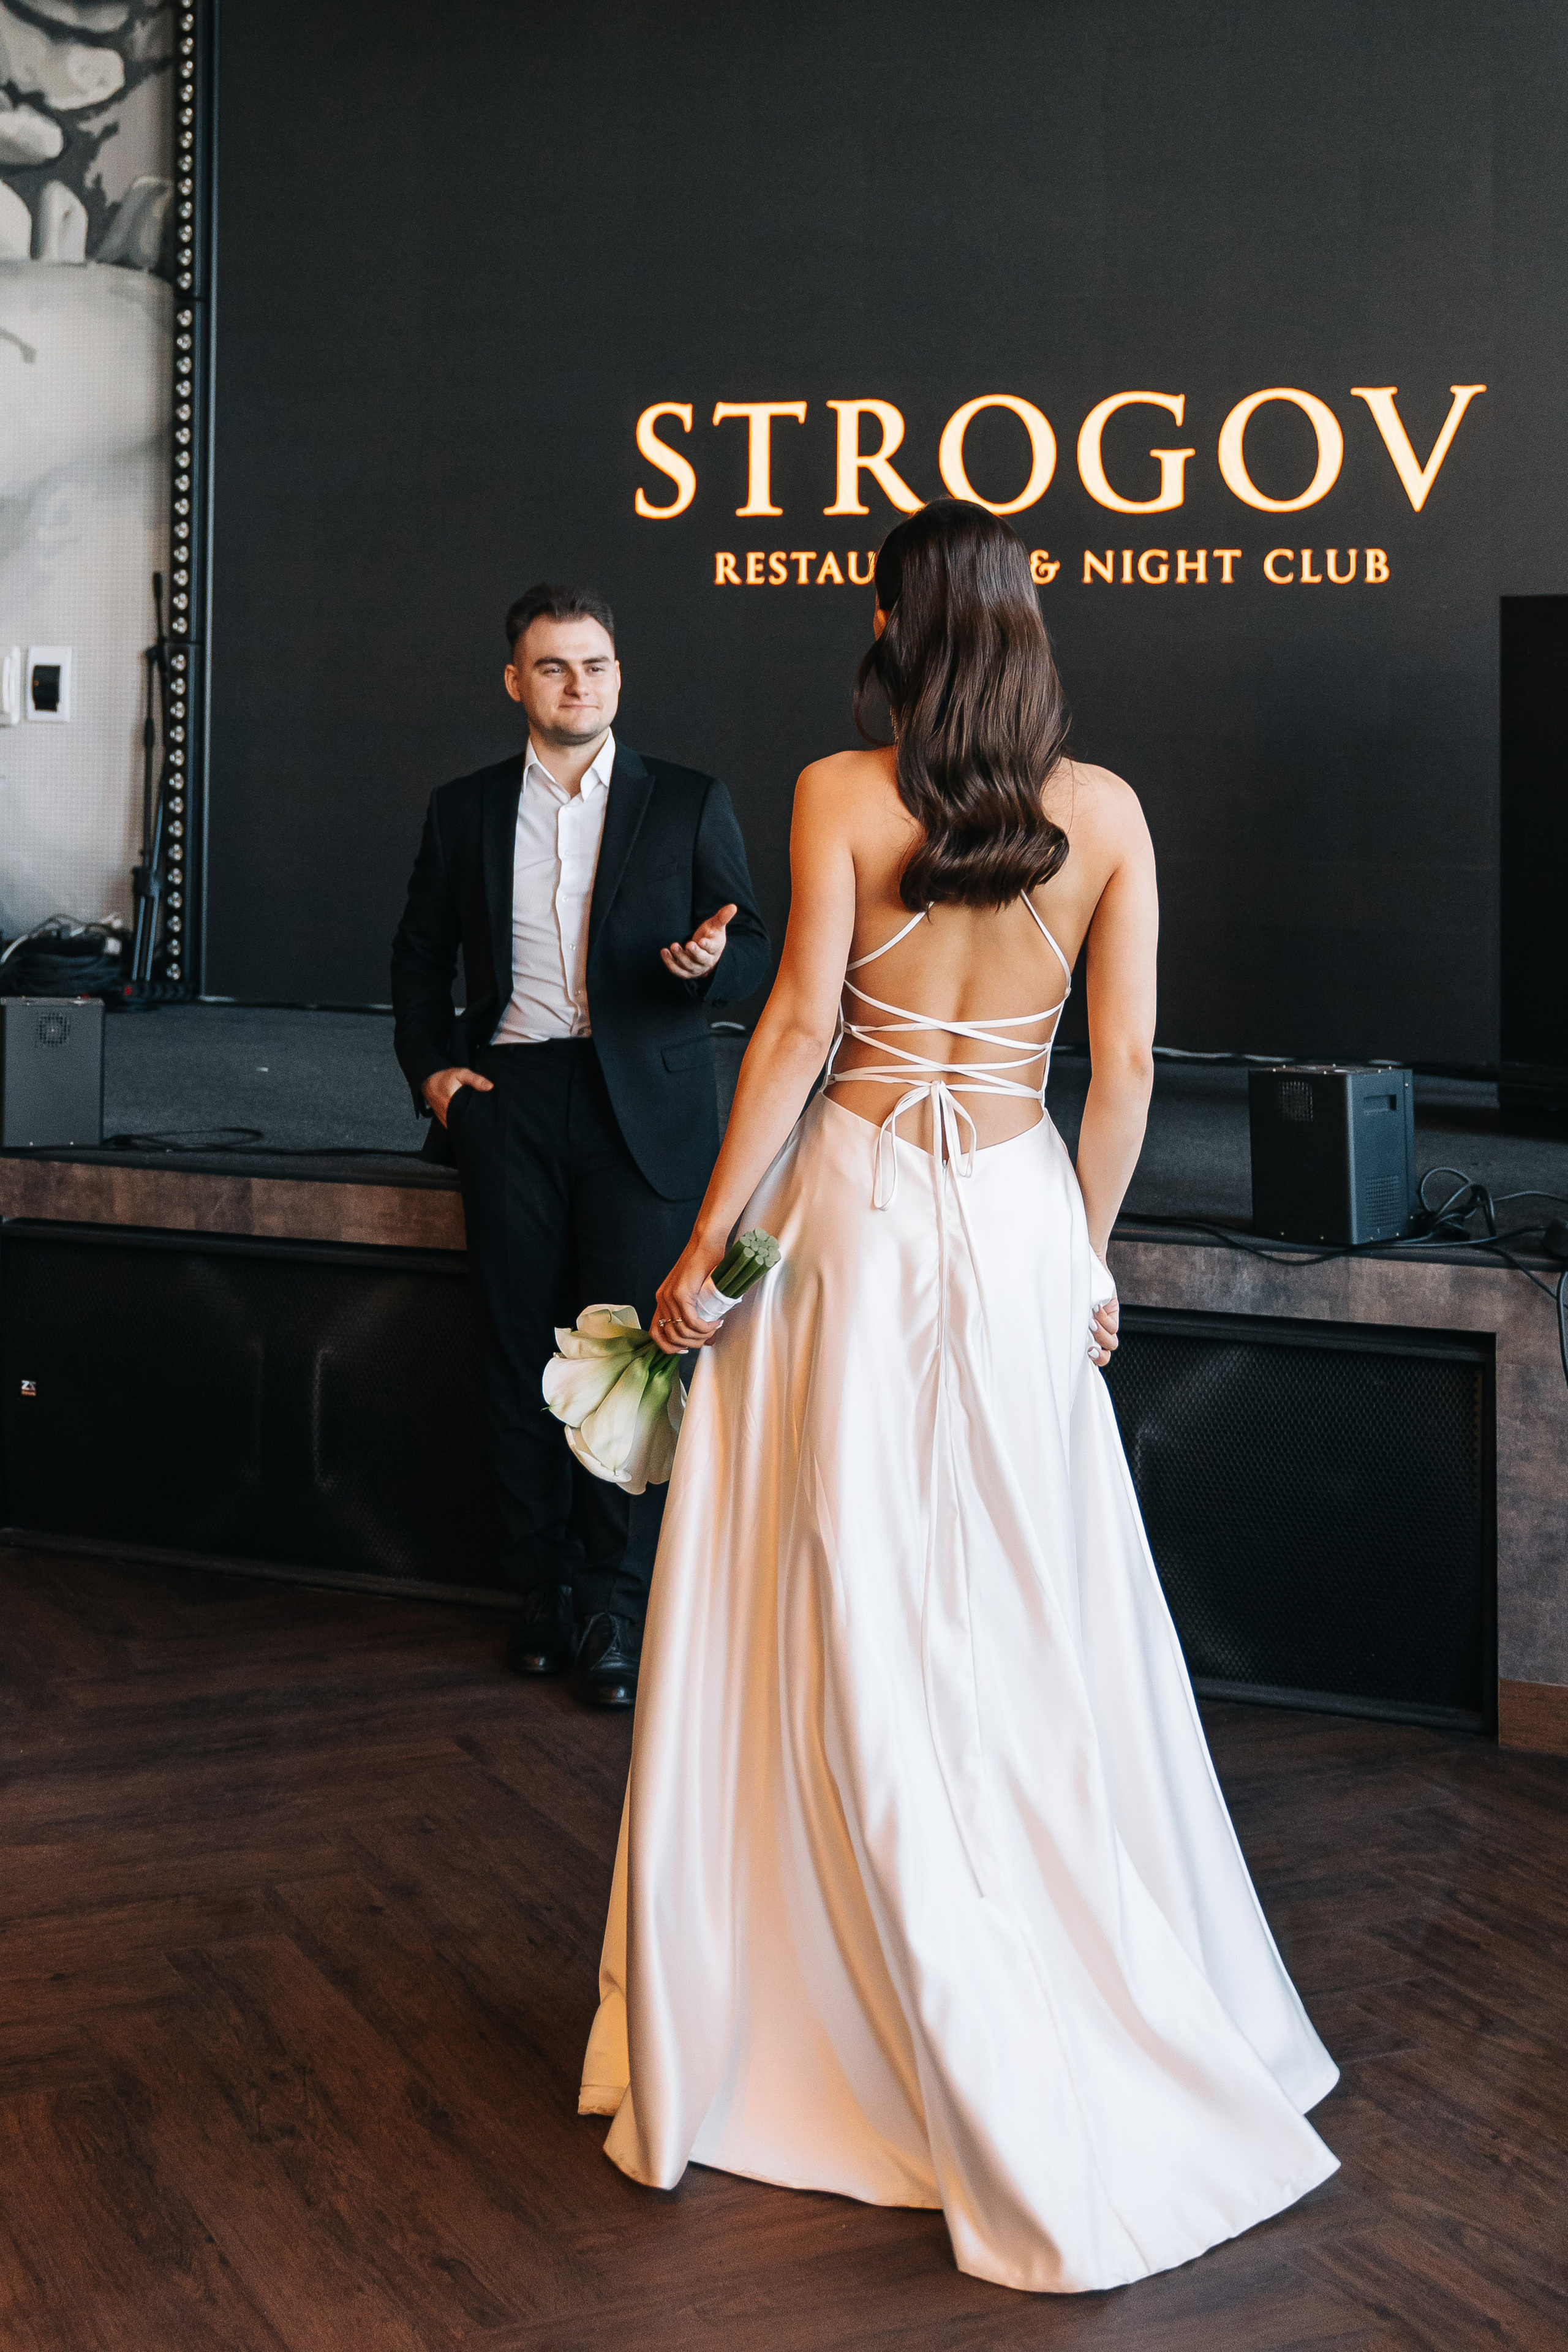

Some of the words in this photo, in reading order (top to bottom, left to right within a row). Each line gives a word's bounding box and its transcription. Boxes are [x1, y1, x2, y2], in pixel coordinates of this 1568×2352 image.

[635, 383, 1487, 520] STROGOV
[714, 550, 876, 586] RESTAU
[1030, 549, 1061, 585] &
[1082, 548, 1242, 584] NIGHT
[1263, 548, 1390, 585] CLUB
